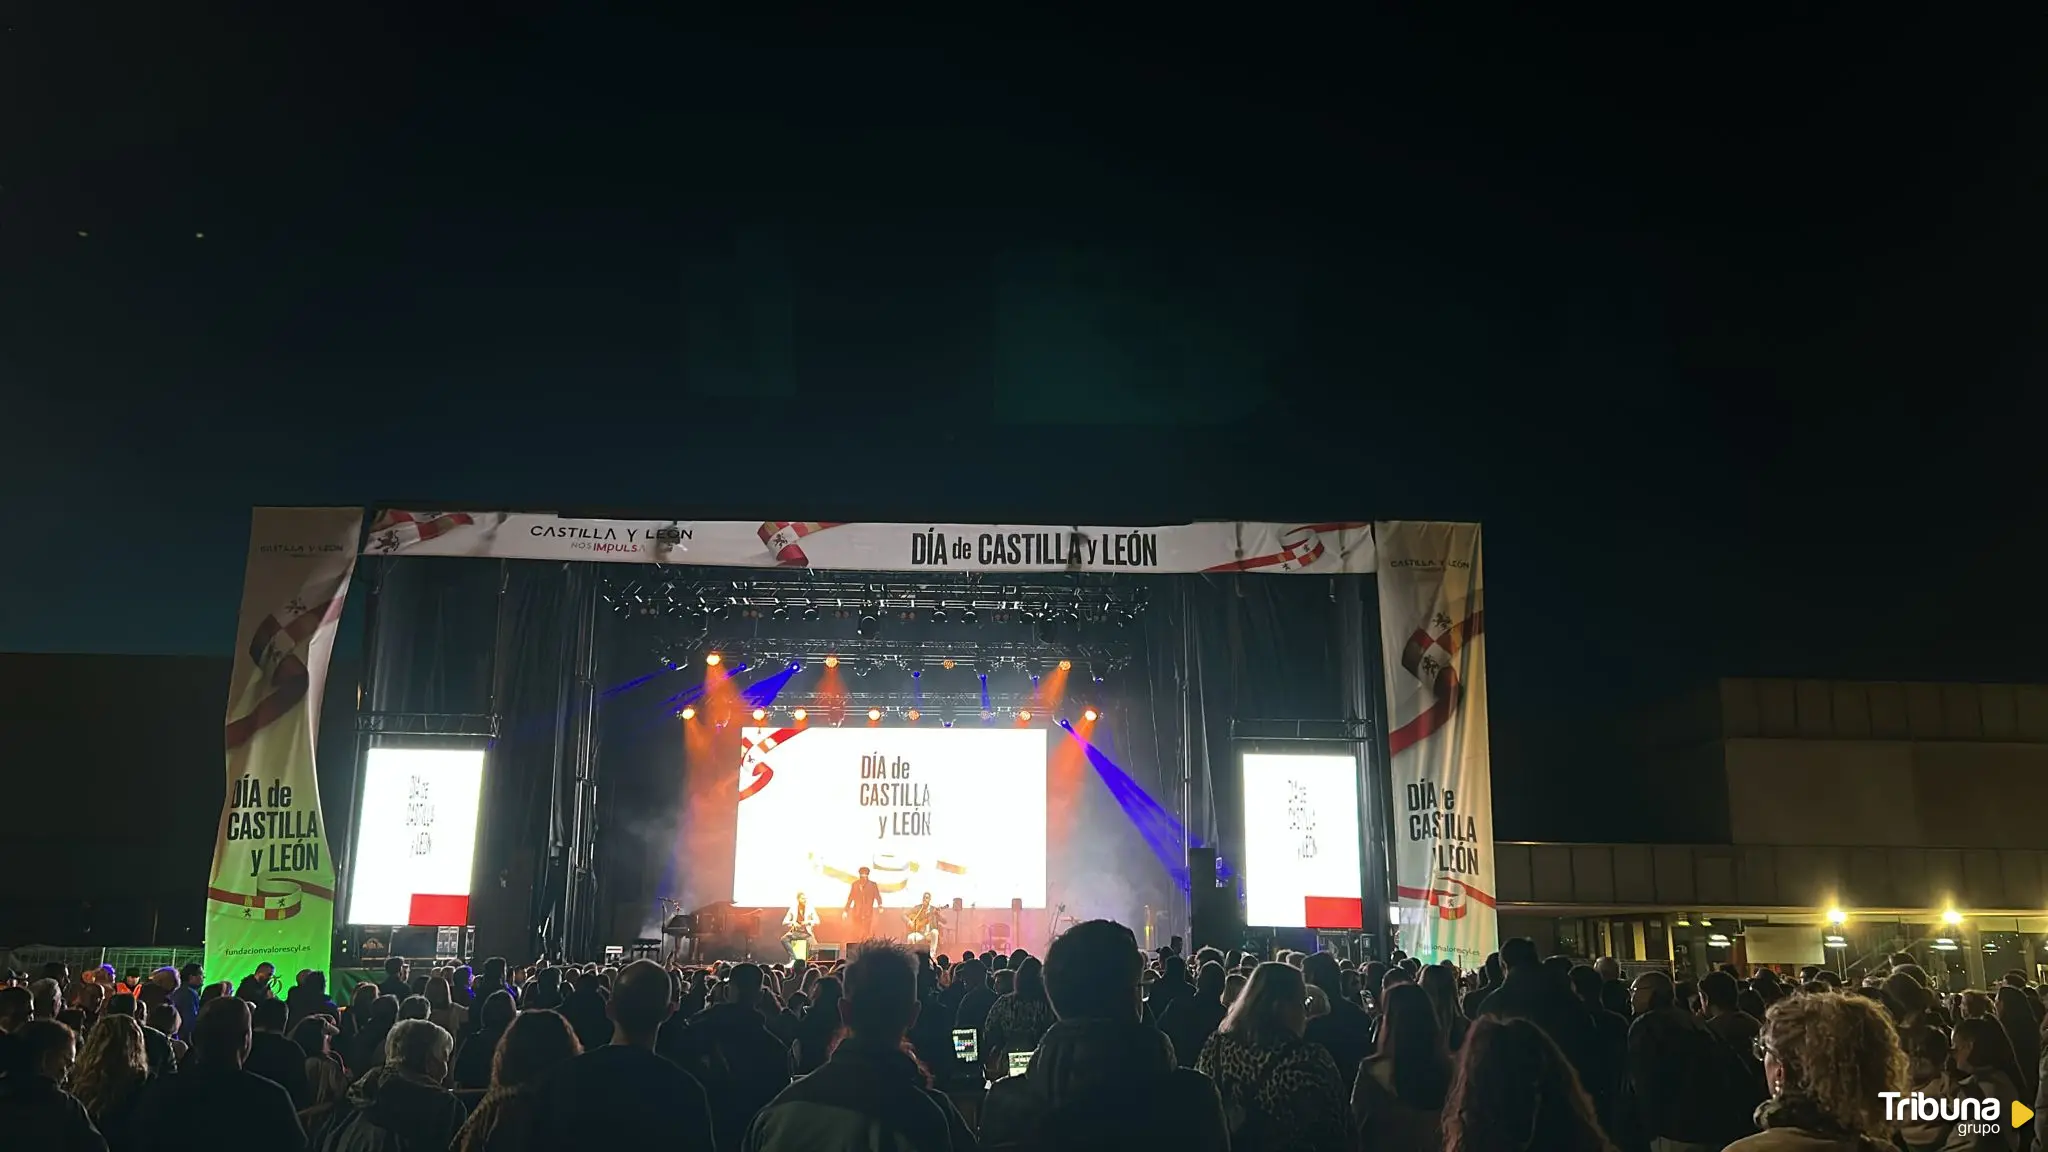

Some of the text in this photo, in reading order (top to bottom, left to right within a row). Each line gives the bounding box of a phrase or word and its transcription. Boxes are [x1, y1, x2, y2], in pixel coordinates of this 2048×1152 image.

[530, 525, 617, 540] CASTILLA
[627, 528, 638, 543] Y
[911, 527, 1157, 566] DÍA de CASTILLA y LEÓN
[861, 751, 910, 779] DÍA de
[231, 774, 292, 808] DÍA de
[860, 783, 931, 807] CASTILLA
[1407, 778, 1455, 811] DÍA e
[227, 811, 318, 840] CASTILLA
[878, 808, 931, 839] y LEÓN
[251, 839, 318, 877] y LEÓN
[1438, 841, 1479, 875] LEÓN
[225, 945, 311, 956] fundacionvalorescyl.es
